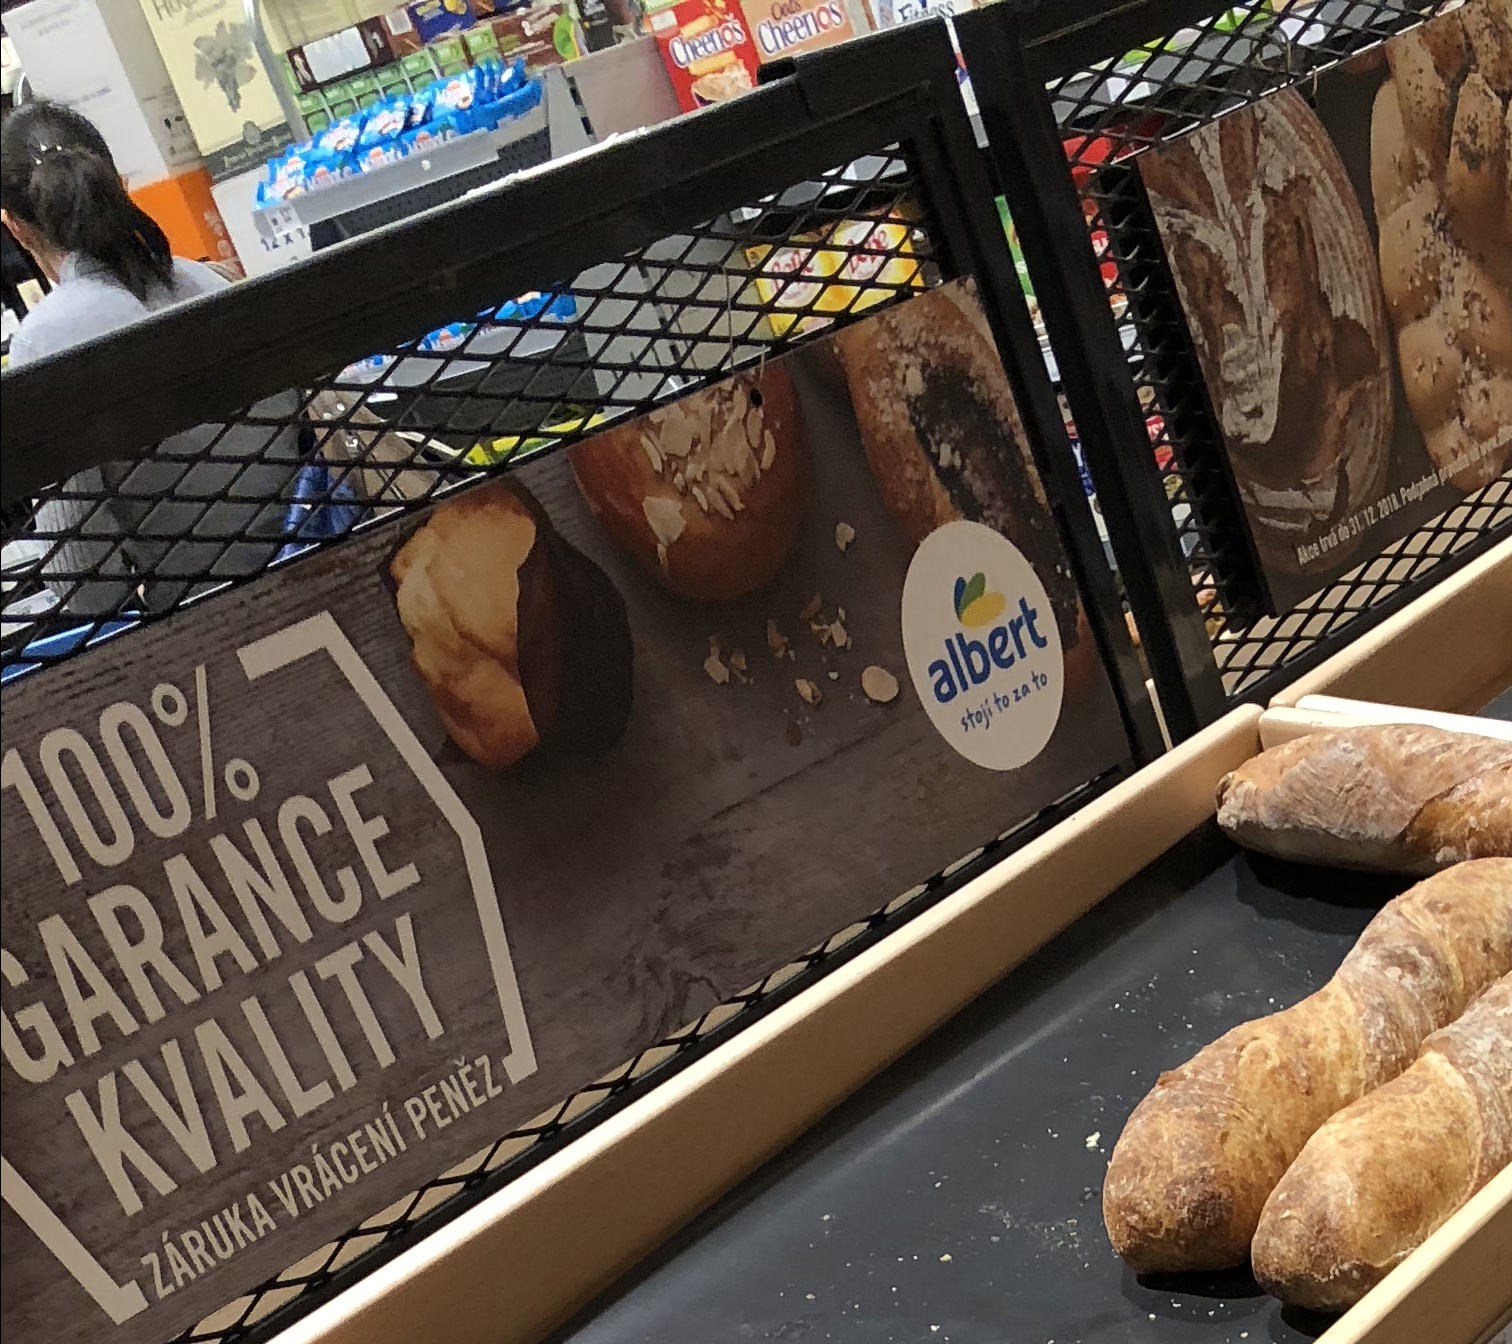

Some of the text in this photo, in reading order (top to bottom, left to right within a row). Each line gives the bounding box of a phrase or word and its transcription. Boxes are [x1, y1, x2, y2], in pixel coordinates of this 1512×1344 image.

[670, 20, 746, 67] Cheerios
[758, 2, 843, 55] Cheerios
[927, 596, 1048, 703] albert
[960, 670, 1048, 732] stojí to za to
[1, 665, 260, 886] 100%
[1, 763, 422, 1084] GARANCE
[65, 912, 445, 1217] KVALITY
[140, 1053, 504, 1300] ZÁRUKA VRÁCENÍ PENĚZ
